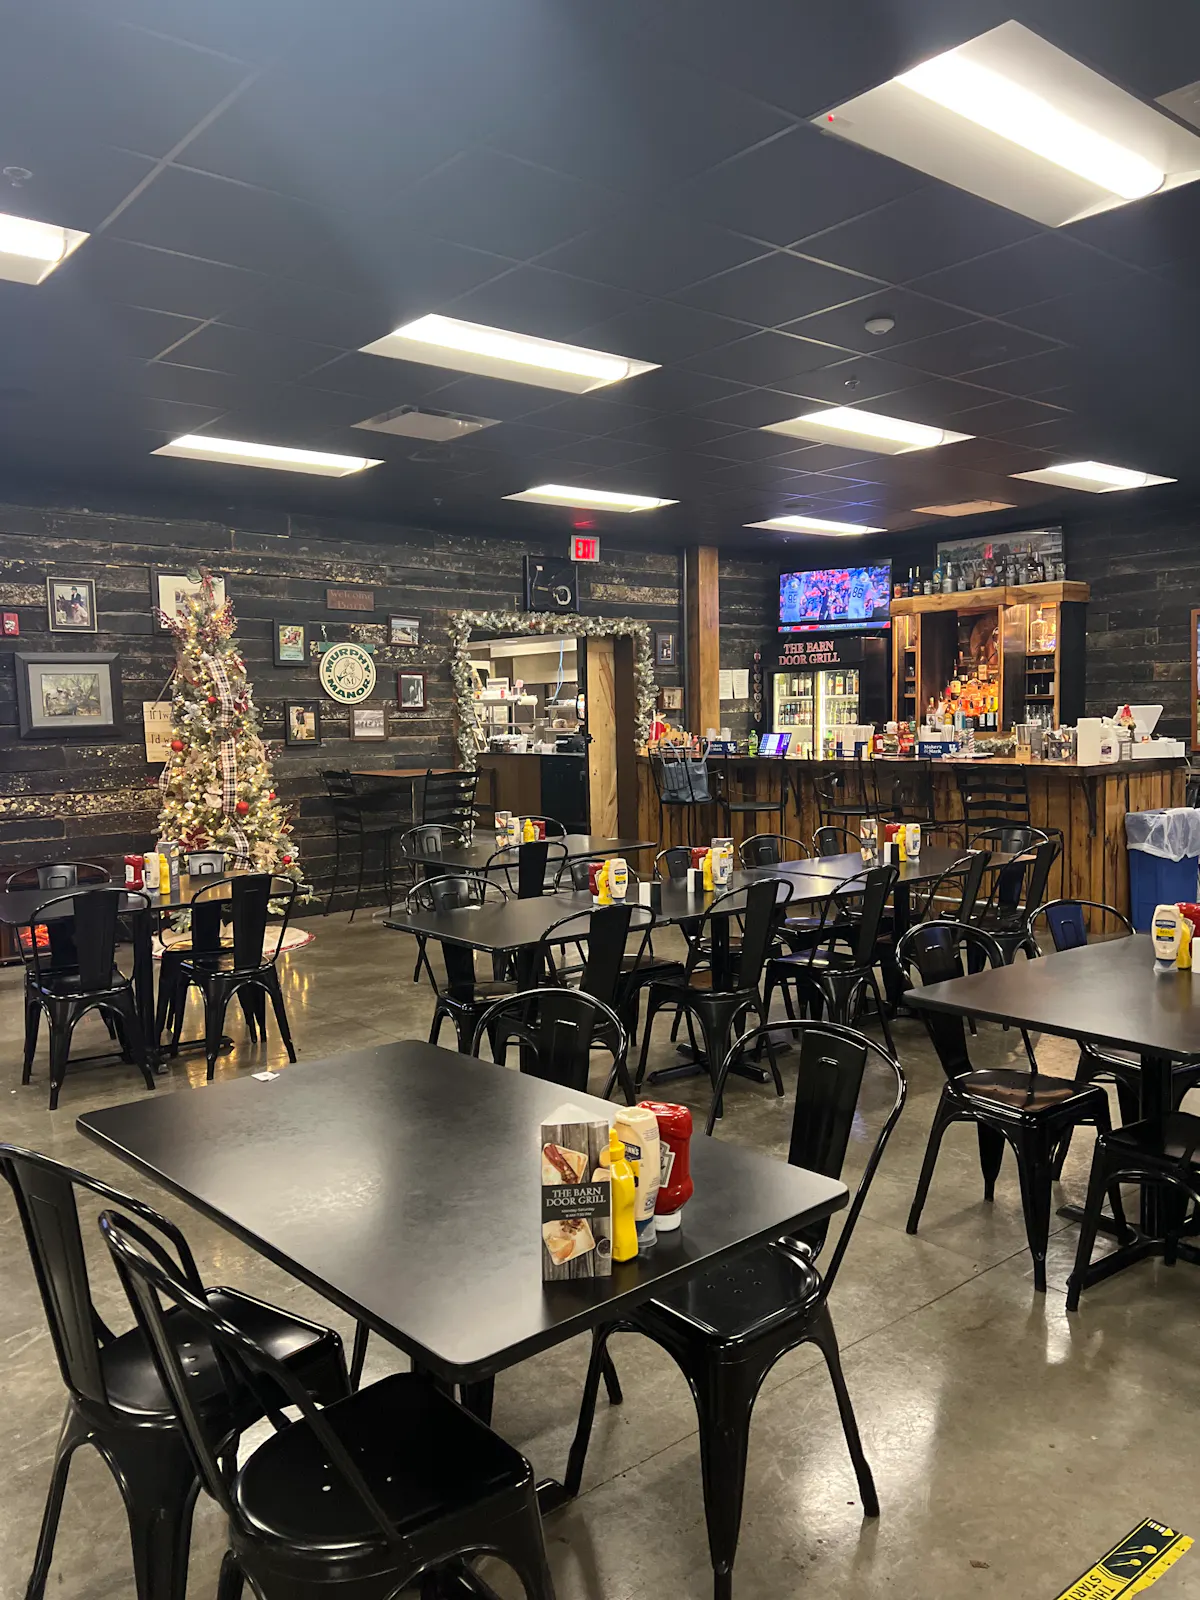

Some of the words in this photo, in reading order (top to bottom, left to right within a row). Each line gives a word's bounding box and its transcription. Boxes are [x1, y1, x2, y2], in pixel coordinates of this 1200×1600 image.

[575, 537, 597, 560] EXIT
[329, 590, 373, 600] Welcome
[783, 642, 805, 655] THE
[806, 640, 835, 653] BARN
[325, 648, 371, 673] MURPHY
[778, 654, 808, 666] DOOR
[808, 651, 841, 664] GRILL
[327, 678, 370, 699] MANOR
[552, 1189, 572, 1199] THE
[573, 1186, 602, 1197] BARN
[546, 1197, 577, 1207] DOOR
[577, 1194, 607, 1205] GRILL
[1063, 1574, 1102, 1600] START
